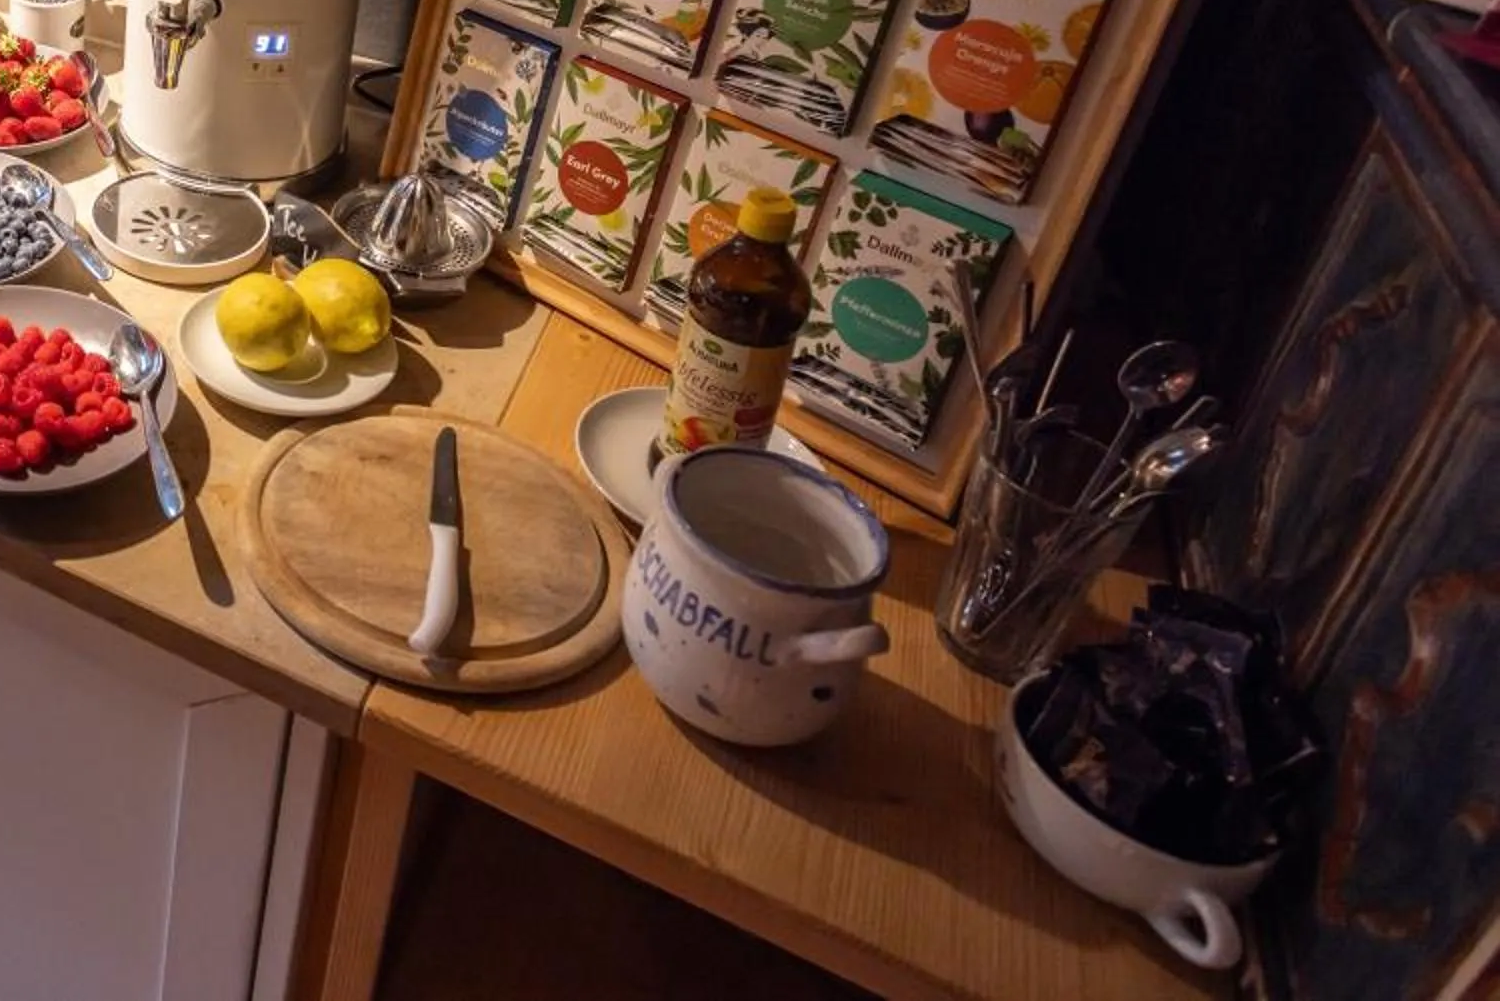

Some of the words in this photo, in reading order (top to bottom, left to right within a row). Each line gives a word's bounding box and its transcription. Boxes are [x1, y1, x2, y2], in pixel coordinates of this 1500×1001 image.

[566, 154, 592, 174] Earl
[591, 166, 621, 190] Grey
[277, 203, 307, 242] Tee
